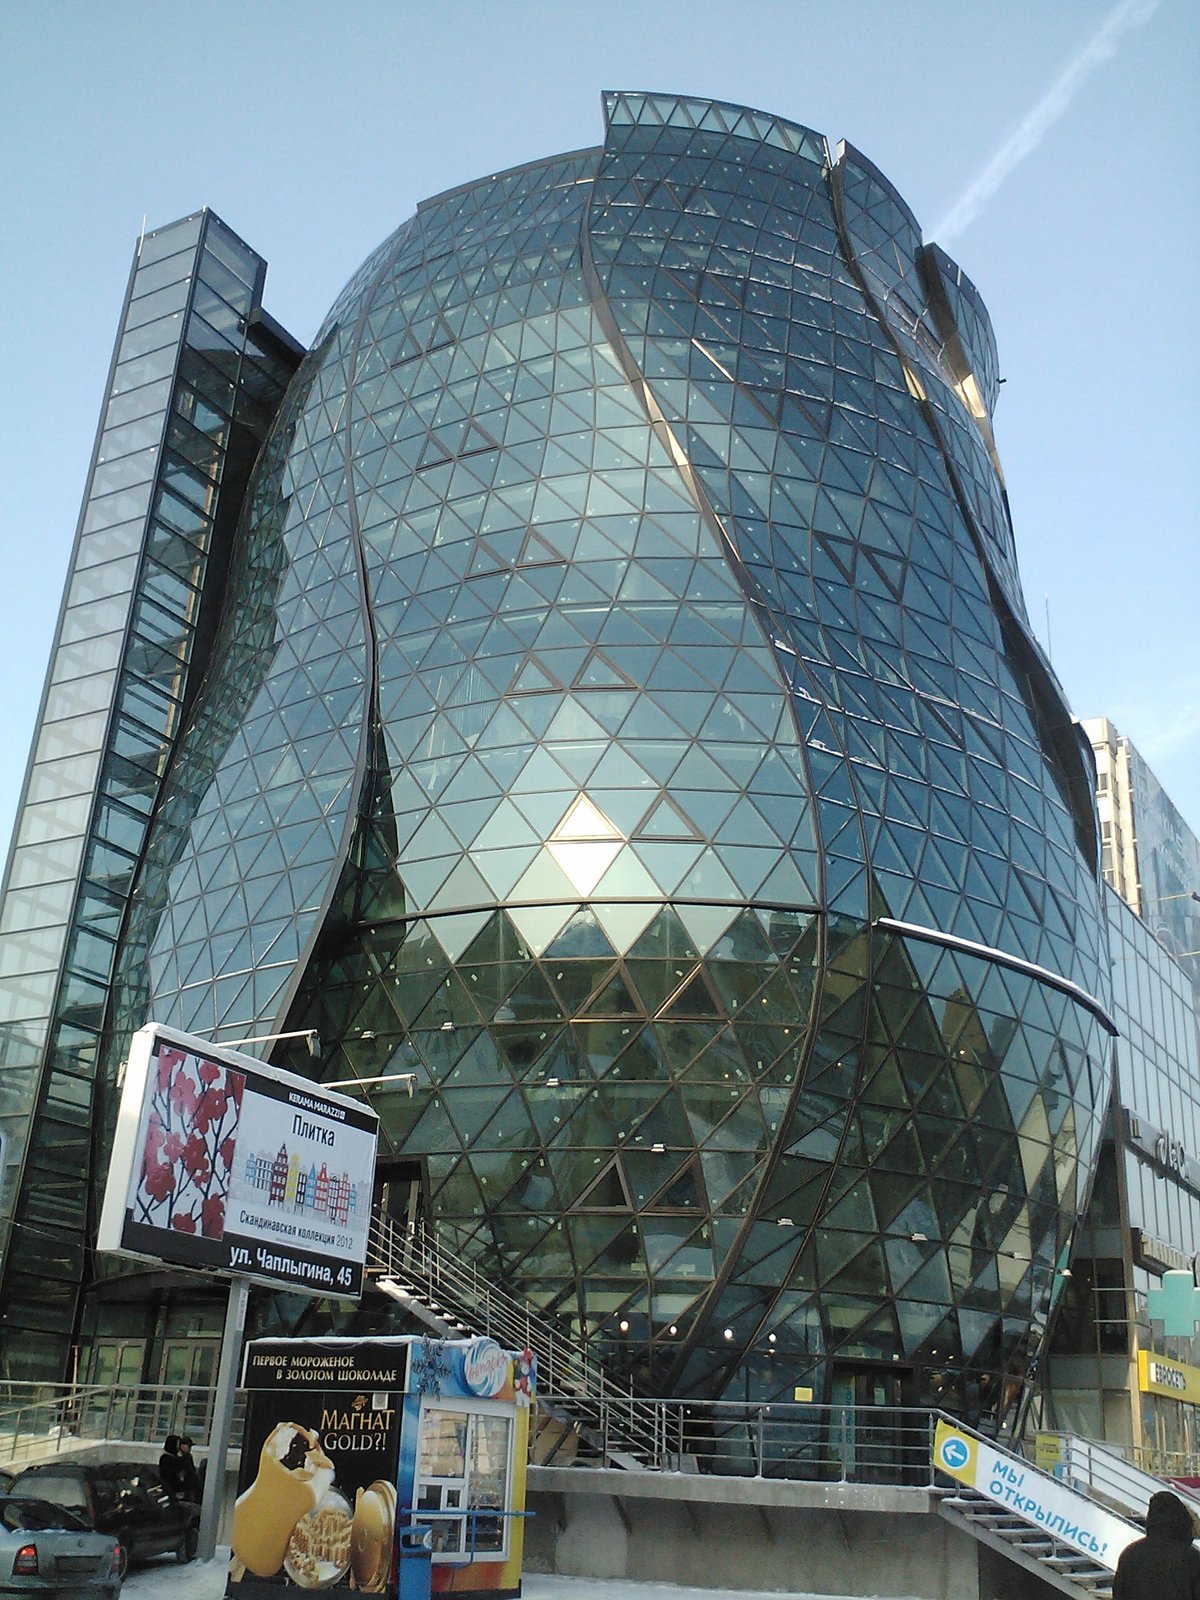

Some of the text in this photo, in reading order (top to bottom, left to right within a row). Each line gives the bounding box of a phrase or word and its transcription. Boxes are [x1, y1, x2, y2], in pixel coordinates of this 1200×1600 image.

[289, 1092, 340, 1118] KERAMA MARAZZI
[292, 1113, 335, 1147] Плитка
[240, 1210, 297, 1237] Скандинавская
[298, 1227, 336, 1247] коллекция
[336, 1234, 353, 1250] 2012
[229, 1246, 353, 1287] ул. Чаплыгина, 45
[252, 1355, 355, 1368] ПЕРВОЕ МОРОЖЕНОЕ
[276, 1369, 397, 1383] В ЗОЛОТОМ ШОКОЛАДЕ
[992, 1459, 1025, 1487] МЫ
[989, 1480, 1109, 1557] ОТКРЫЛИСЬ!
